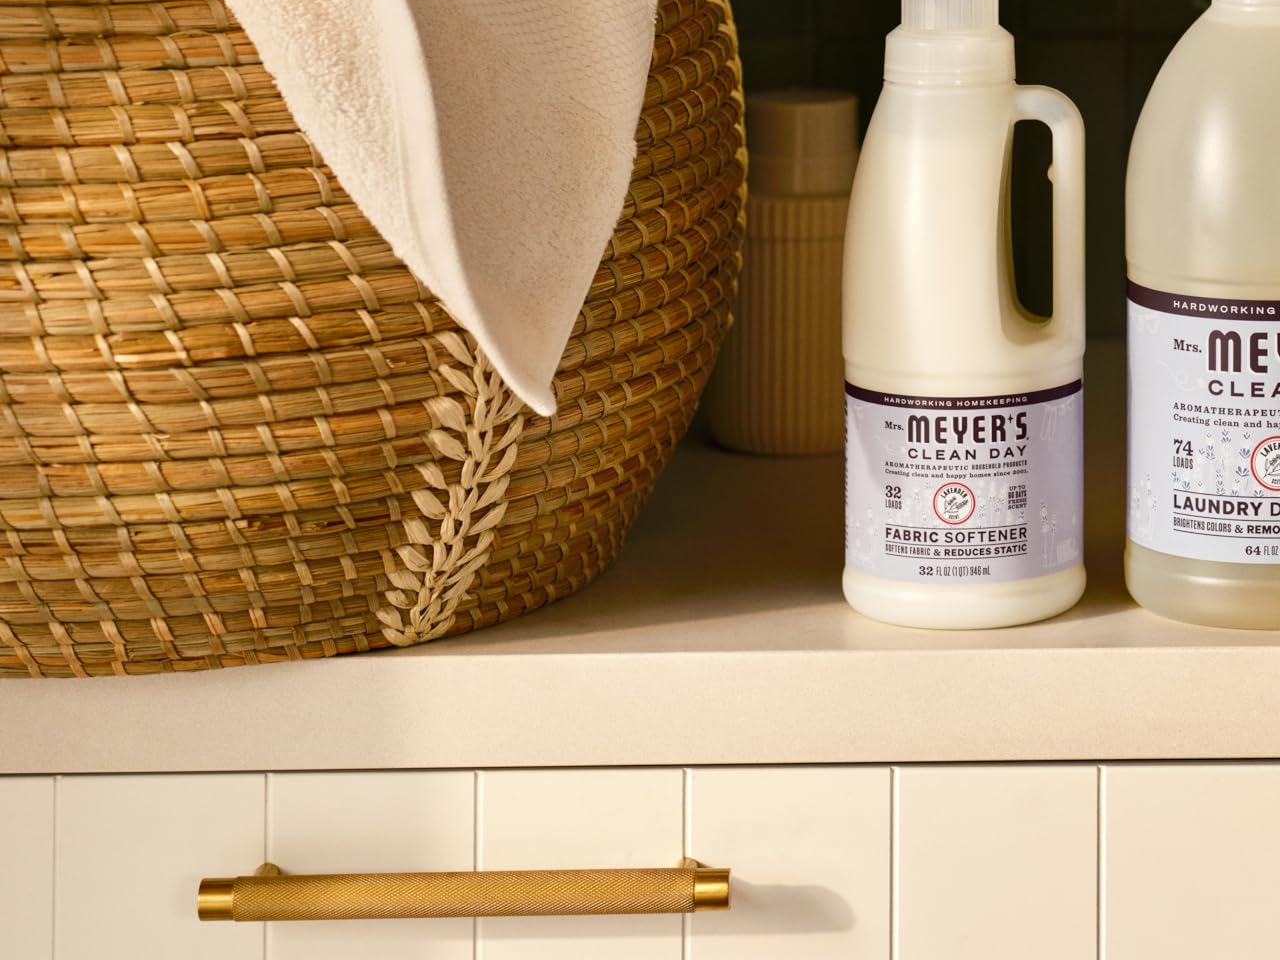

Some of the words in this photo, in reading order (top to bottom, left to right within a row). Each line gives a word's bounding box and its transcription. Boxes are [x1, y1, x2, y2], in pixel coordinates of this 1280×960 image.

[1173, 300, 1275, 315] HARDWORKING
[1173, 339, 1202, 353] Mrs.
[884, 397, 952, 407] HARDWORKING
[957, 397, 1028, 407] HOMEKEEPING
[885, 421, 904, 431] Mrs.
[1173, 413, 1210, 426] Creating
[1214, 419, 1239, 427] clean
[1243, 420, 1262, 428] and
[908, 448, 976, 460] CLEAN
[990, 445, 1027, 459] DAY
[1173, 439, 1193, 456] 74
[885, 462, 968, 470] AROMATHERAPEUTIC
[1173, 456, 1193, 469] LOADS
[885, 469, 909, 478] Creating
[885, 485, 902, 499] 32
[941, 488, 968, 498] LAVENDER
[885, 500, 902, 510] LOADS
[1173, 494, 1263, 516] LAUNDRY
[1173, 517, 1205, 531] BRIGHTENS
[1207, 522, 1232, 533] COLORS
[1235, 525, 1244, 533] &
[885, 528, 939, 543] FABRIC
[944, 527, 1027, 543] SOFTENER
[910, 547, 930, 556] FABRIC
[944, 548, 991, 556] REDUCES
[994, 544, 1027, 554] STATIC
[1245, 546, 1261, 556] 64
[1263, 546, 1270, 556] FL
[919, 566, 933, 575] 32
